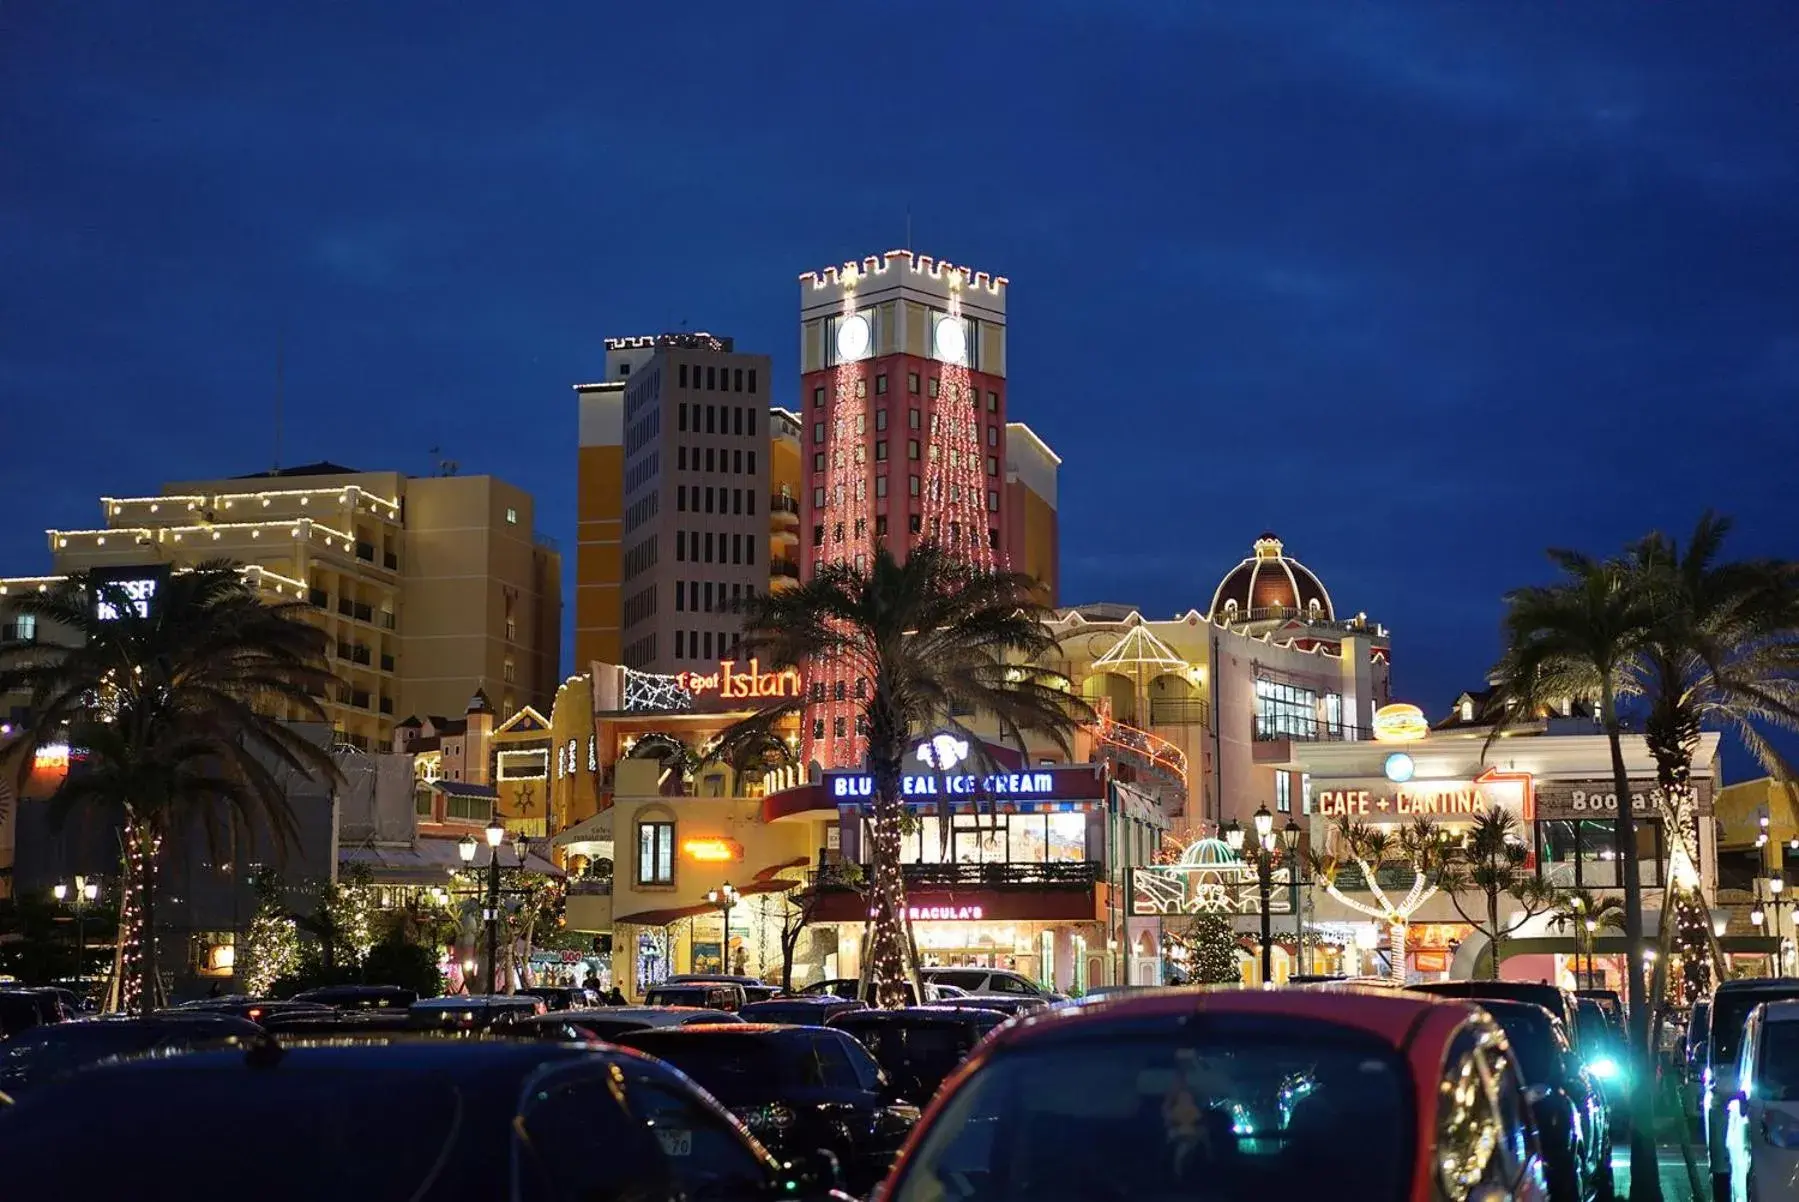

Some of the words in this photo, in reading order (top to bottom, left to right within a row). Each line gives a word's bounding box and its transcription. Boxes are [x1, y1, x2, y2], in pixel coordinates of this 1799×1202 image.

[720, 658, 801, 698] Islan
[835, 777, 873, 796] BLU
[902, 776, 937, 794] EAL
[945, 775, 975, 793] ICE
[983, 774, 1052, 793] CREAM
[1319, 791, 1370, 816] CAFE
[1396, 790, 1486, 815] CANTINA
